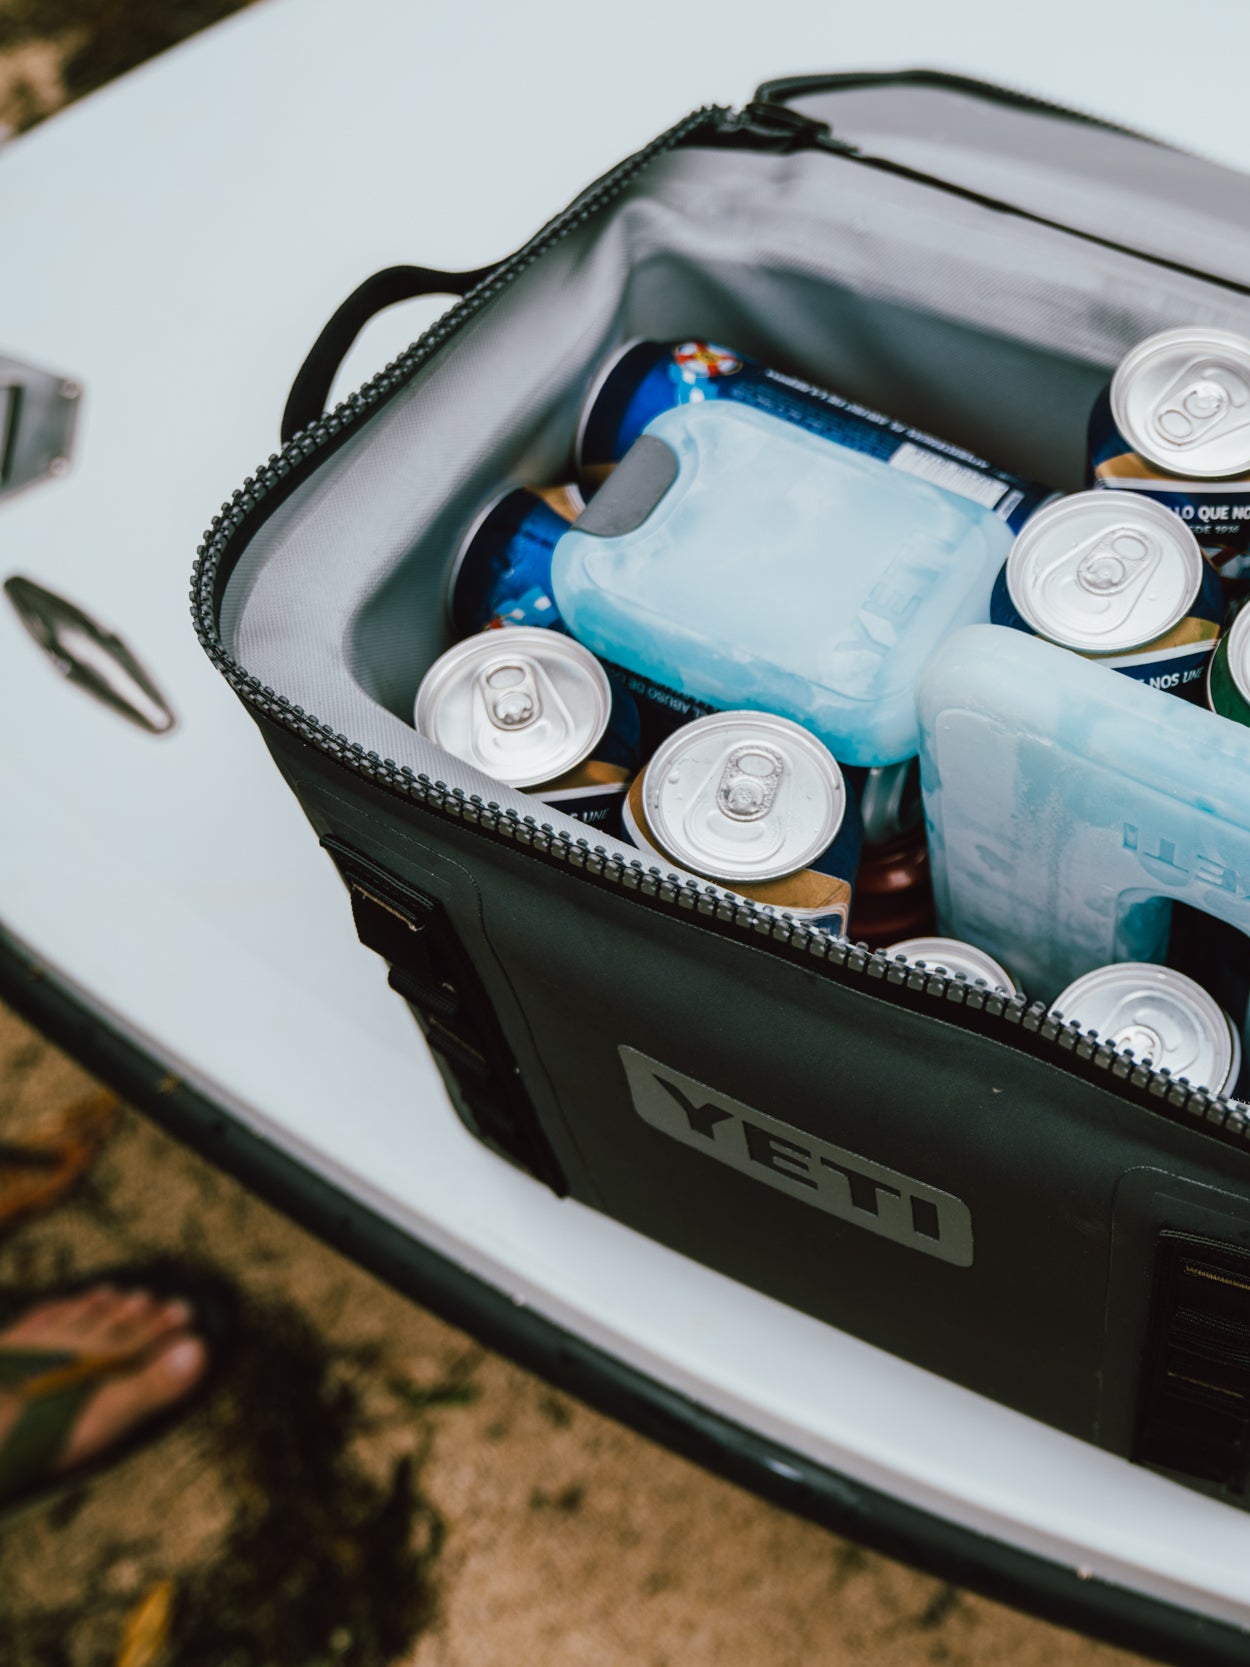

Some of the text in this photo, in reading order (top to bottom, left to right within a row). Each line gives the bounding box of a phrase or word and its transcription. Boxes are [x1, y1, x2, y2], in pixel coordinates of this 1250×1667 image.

[1198, 505, 1229, 522] QUE
[1149, 672, 1180, 690] NOS
[651, 1072, 941, 1241] YETI
